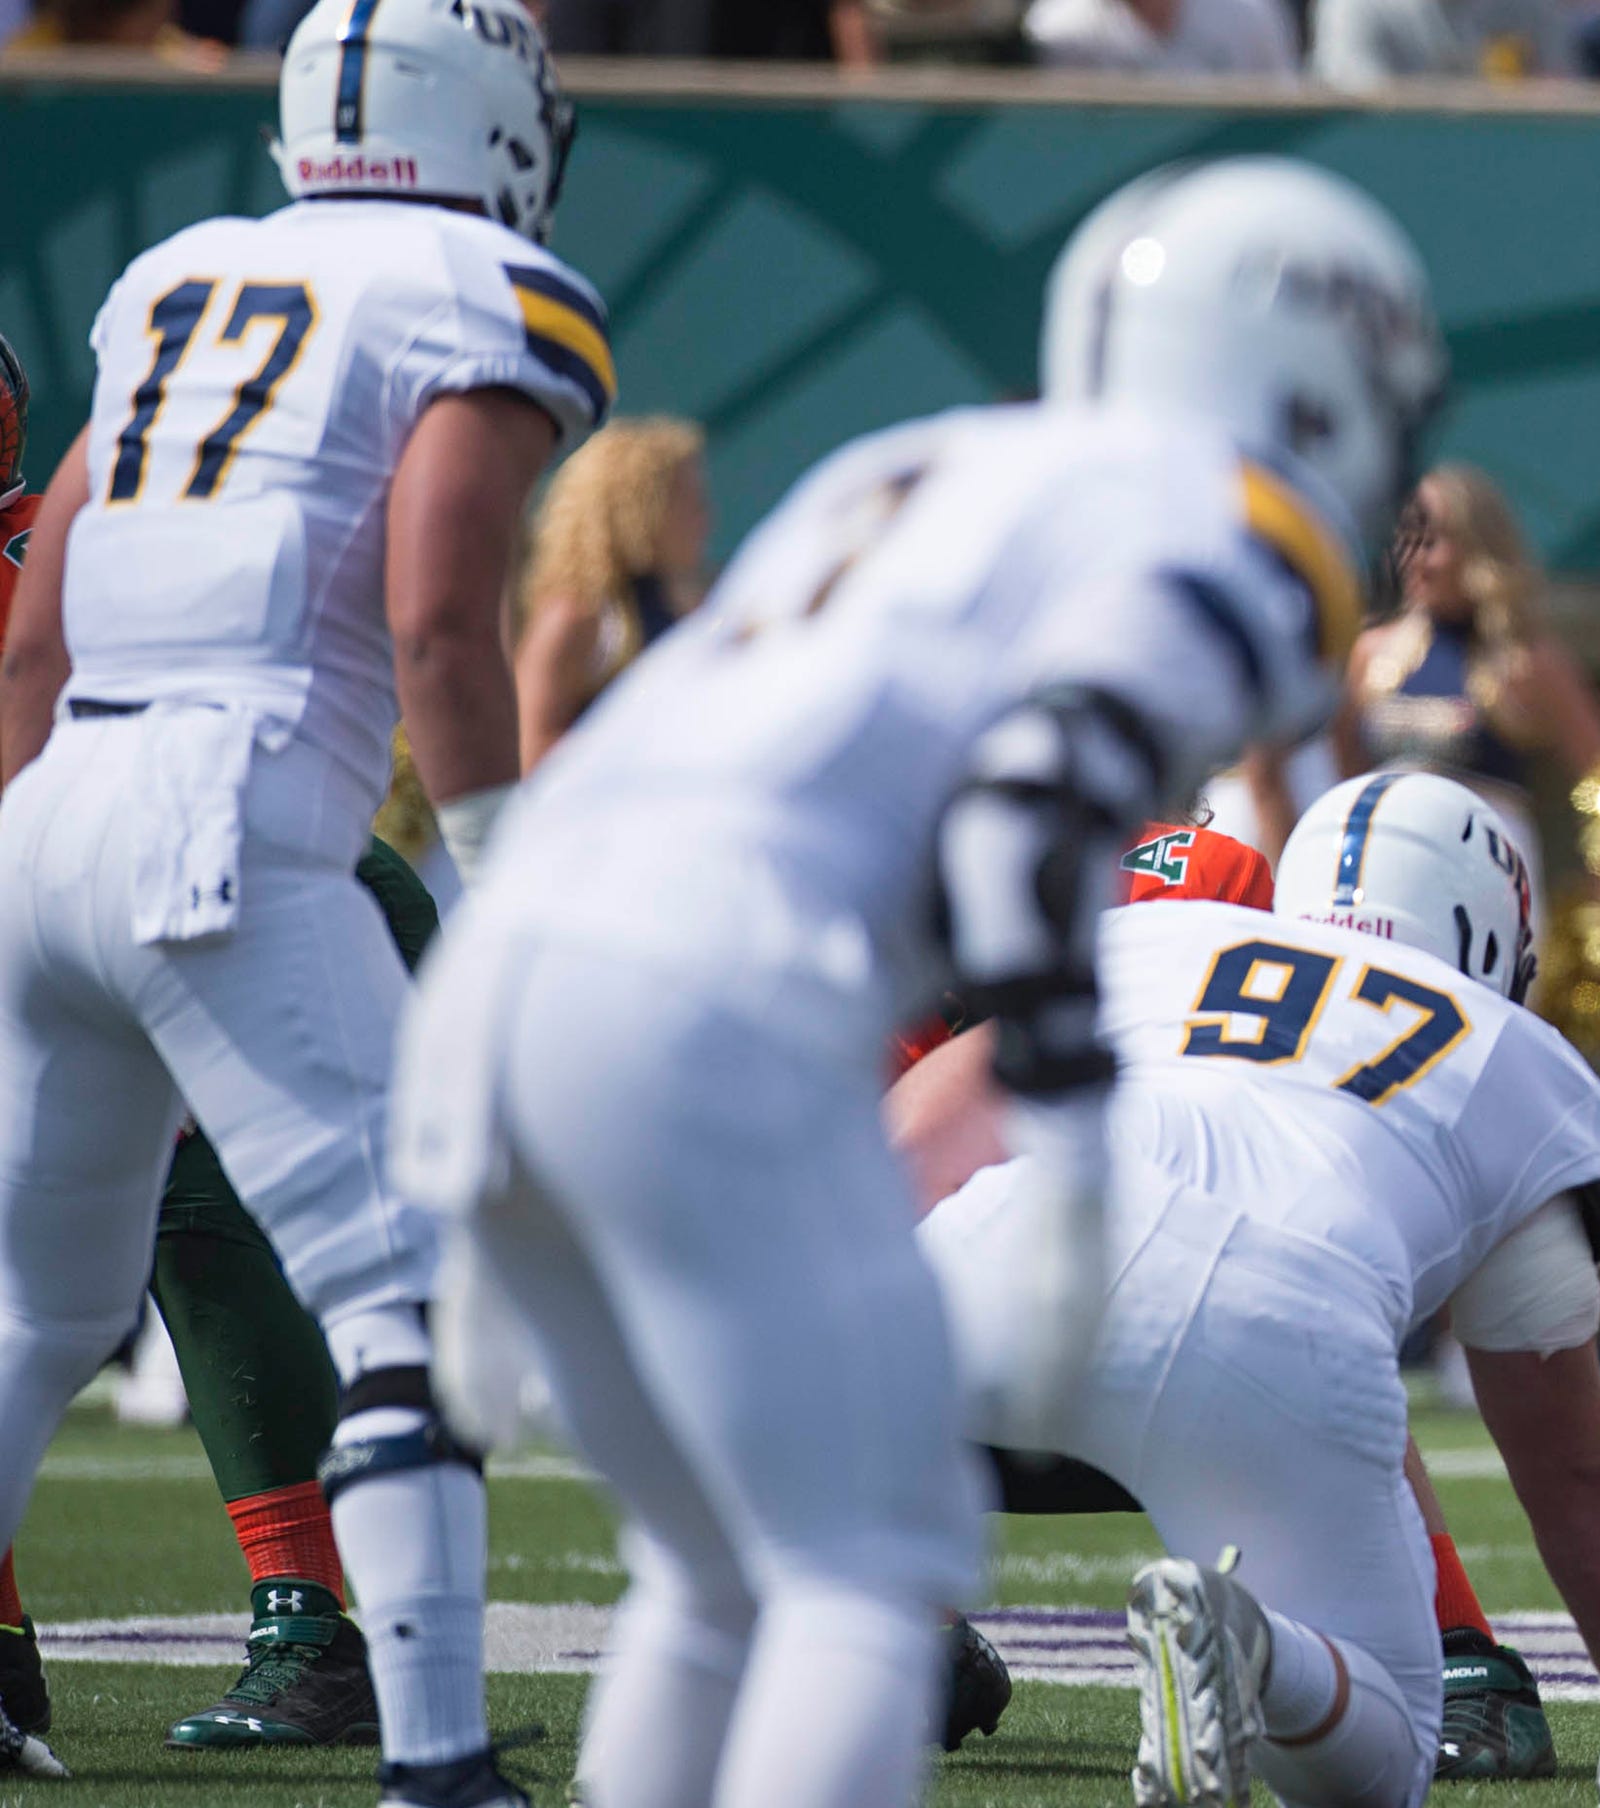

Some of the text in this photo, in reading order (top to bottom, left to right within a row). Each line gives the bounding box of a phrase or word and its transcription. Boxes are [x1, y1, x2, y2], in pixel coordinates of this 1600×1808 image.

[298, 154, 418, 190] Riddell
[105, 276, 323, 510] 17
[1298, 912, 1394, 940] ddell
[1177, 936, 1473, 1108] 97
[249, 1626, 279, 1640] MOUR
[1442, 1665, 1488, 1680] MOUR
